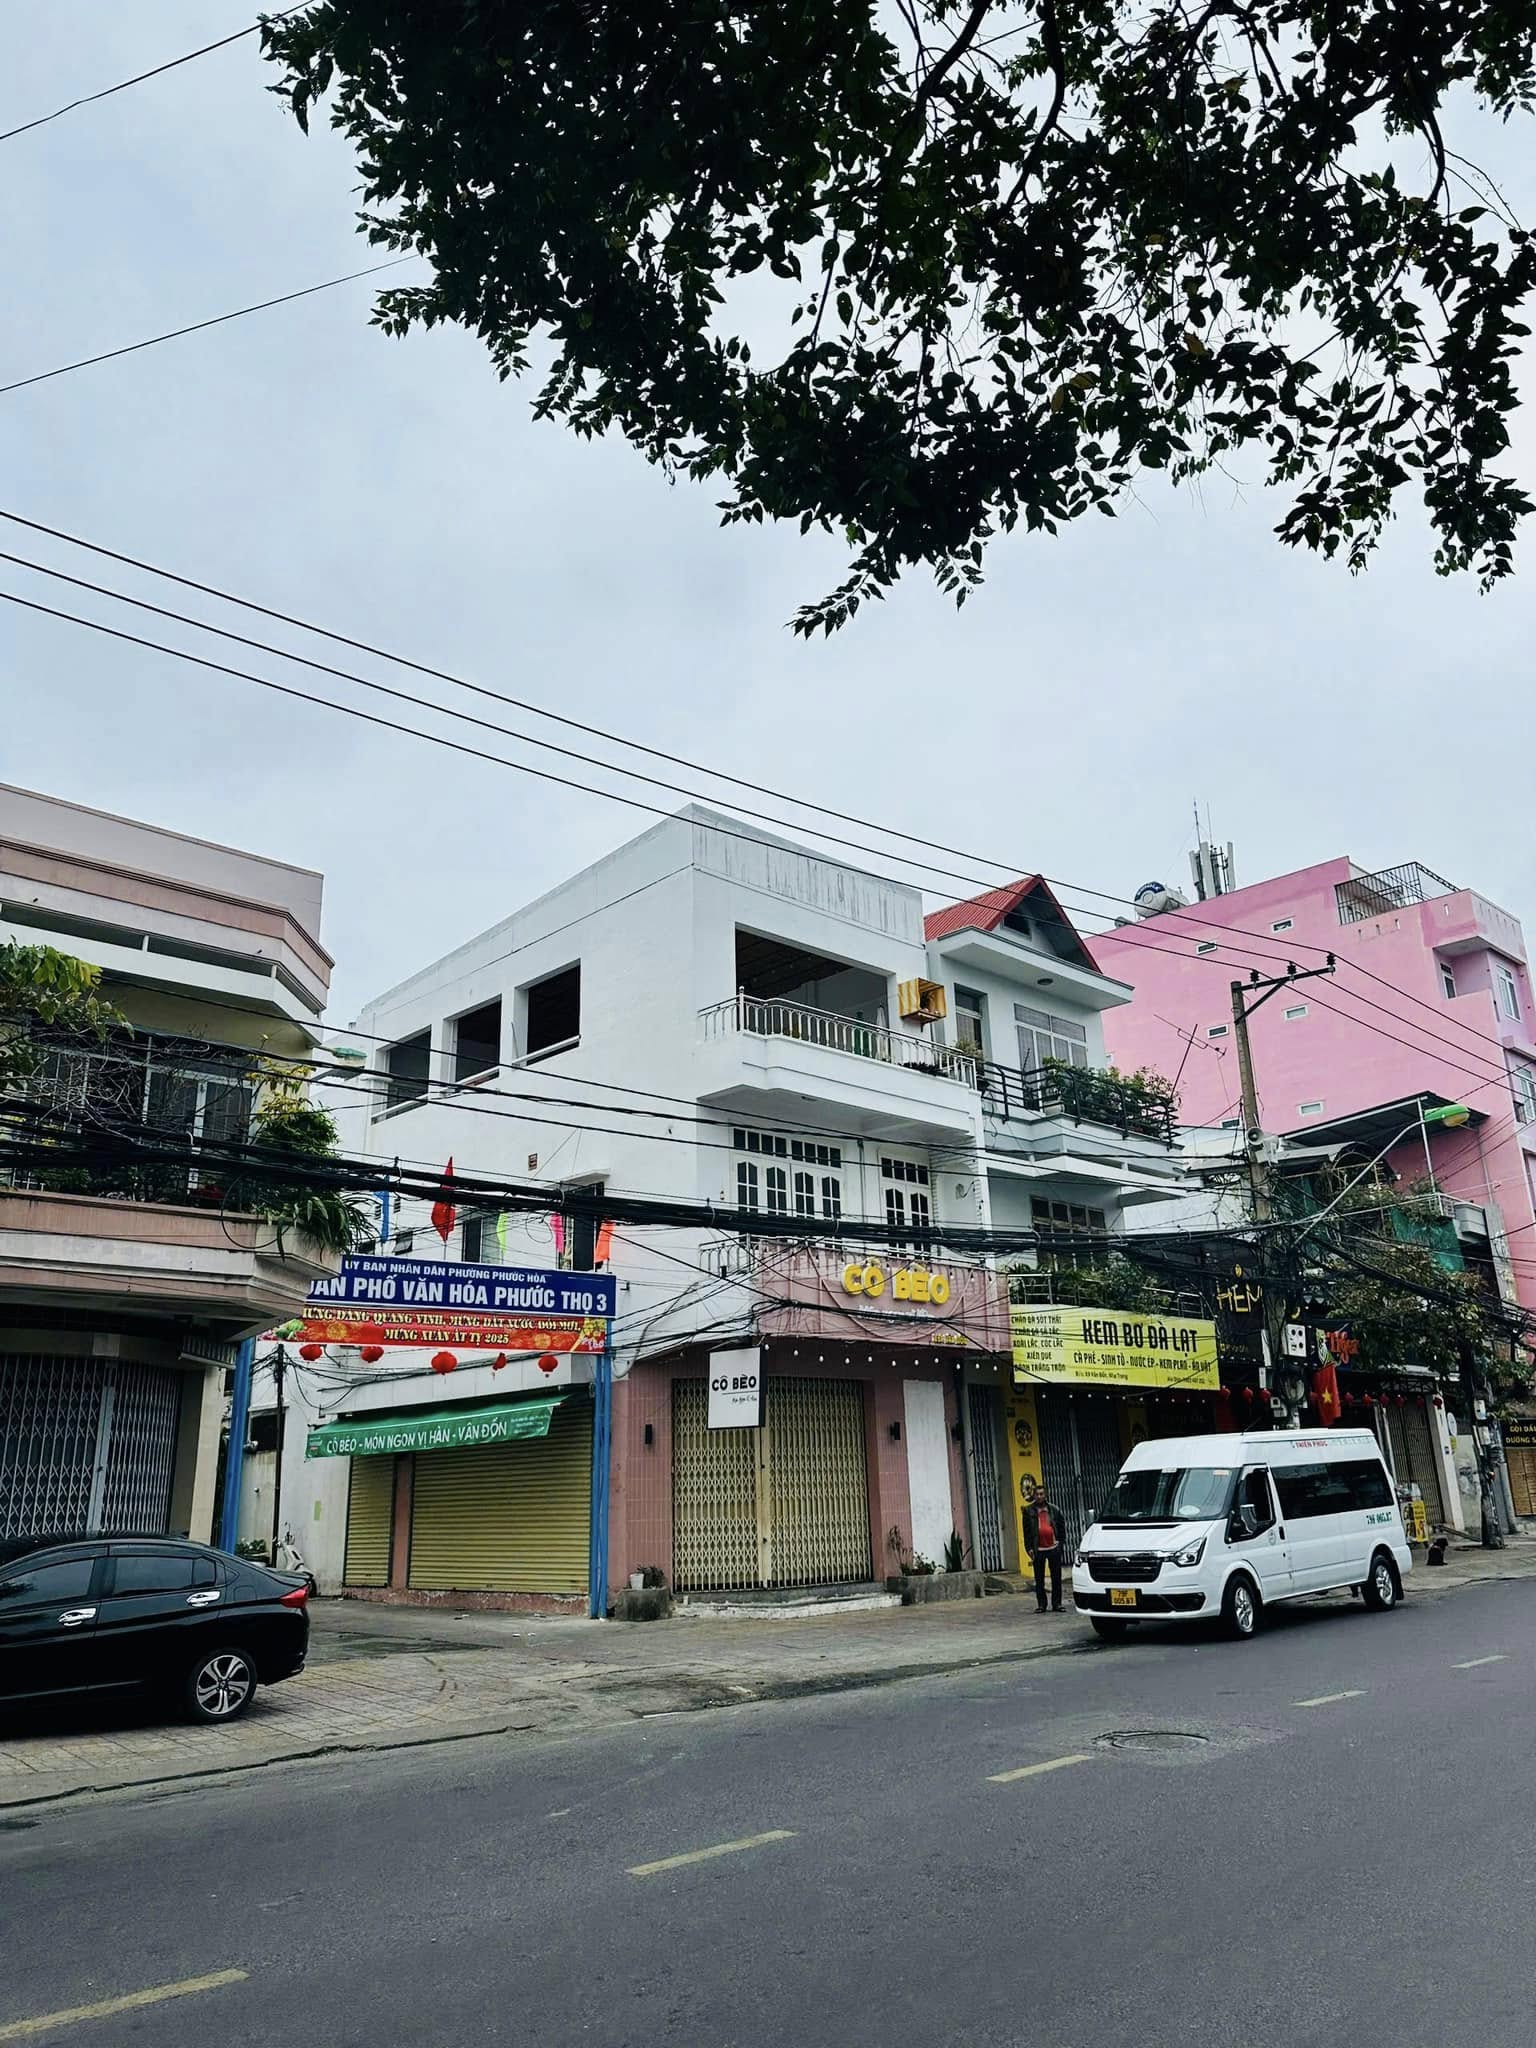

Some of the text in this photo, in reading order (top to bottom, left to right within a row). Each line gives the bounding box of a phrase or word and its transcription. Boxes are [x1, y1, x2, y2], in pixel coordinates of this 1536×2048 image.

[363, 1261, 387, 1273] BAN
[390, 1262, 421, 1275] NHÂN
[424, 1265, 446, 1277] DÂN
[449, 1267, 490, 1280] PHƯỜNG
[492, 1270, 525, 1283] PHƯỚC
[527, 1273, 547, 1284] HÒA
[840, 1256, 951, 1306] CÔ BÈO
[353, 1273, 398, 1299] PHỐ
[403, 1277, 443, 1303] VĂN
[449, 1281, 488, 1305] HÓA
[494, 1285, 556, 1308] PHƯỚC
[561, 1291, 593, 1315] THỌ
[596, 1293, 608, 1312] 3
[373, 1311, 413, 1326] QUANG
[484, 1334, 509, 1345] 2025
[1081, 1318, 1198, 1358] KEM BƠ ĐÀ LẠT
[711, 1373, 757, 1392] CÔ BÈO
[326, 1437, 339, 1454] CÔ
[364, 1432, 385, 1450] MÓN
[387, 1433, 416, 1449] NGON
[417, 1431, 427, 1449] VỊ
[429, 1425, 450, 1444] HÀN
[458, 1422, 480, 1441] VÂN
